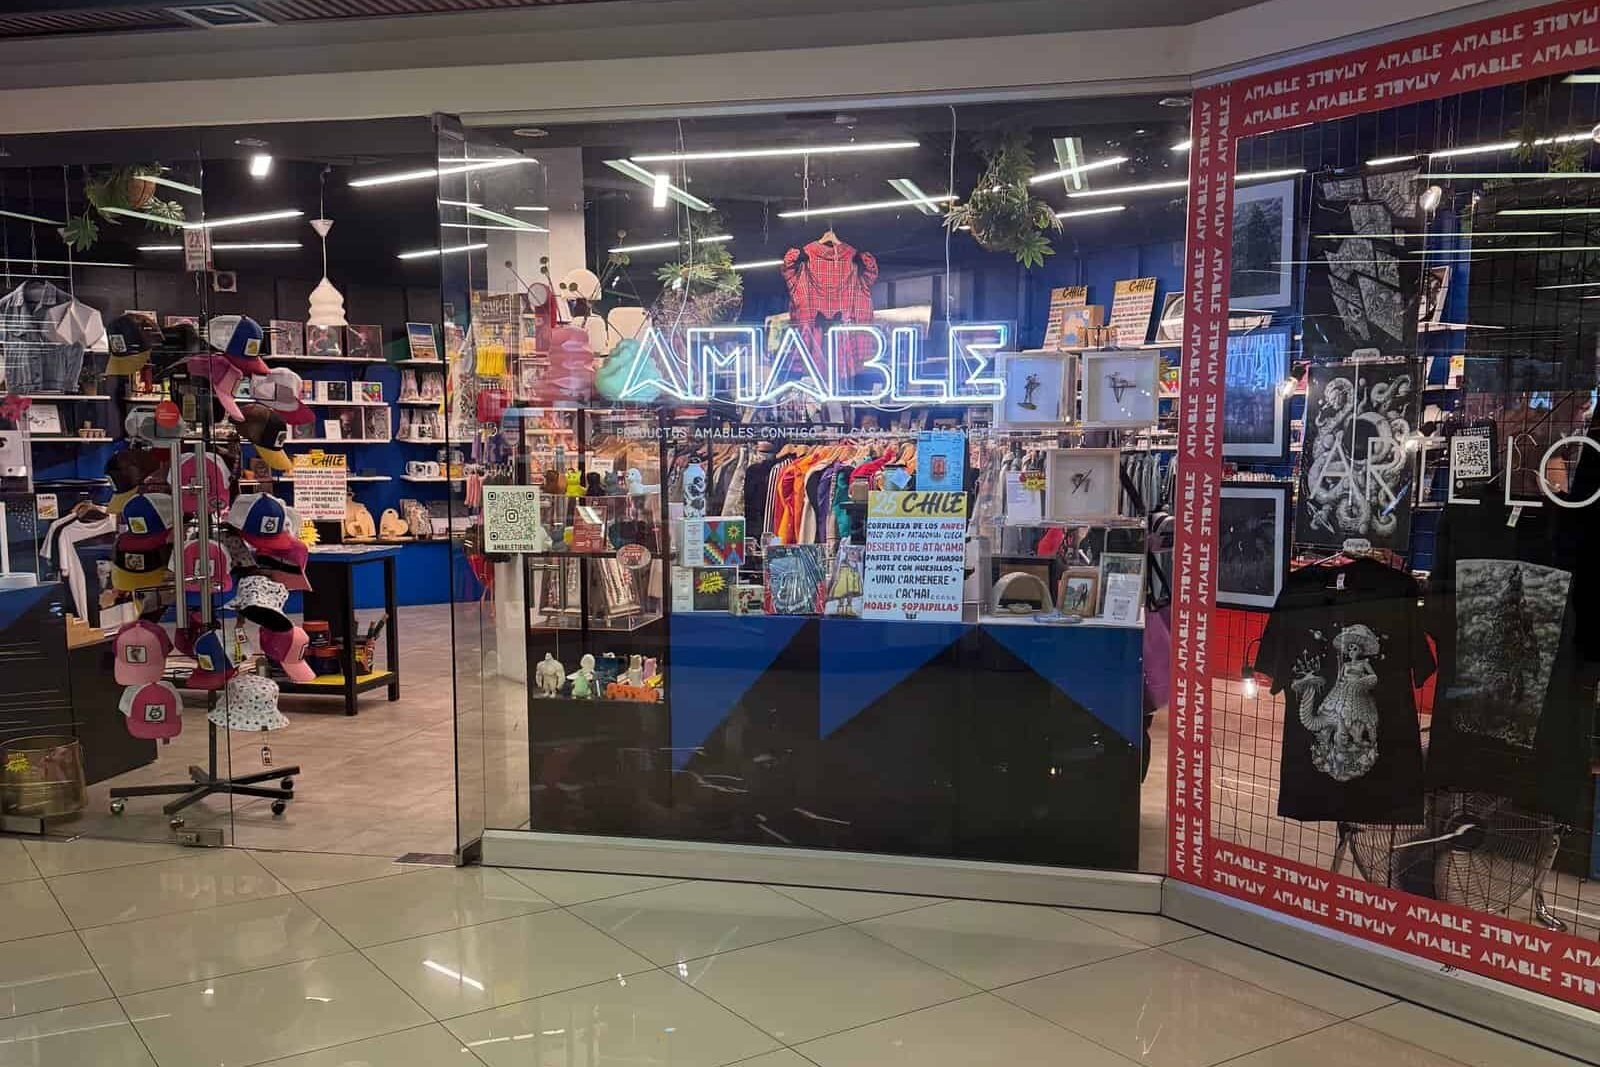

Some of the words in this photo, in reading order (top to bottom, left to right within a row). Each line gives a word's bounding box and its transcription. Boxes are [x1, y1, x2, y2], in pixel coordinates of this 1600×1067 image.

[1243, 101, 1300, 126] AMABLE
[1306, 86, 1368, 113] AMABLE
[1374, 71, 1441, 99] AMABLE
[1450, 52, 1523, 81] AMABLE
[1531, 37, 1600, 65] AMABL
[1244, 76, 1301, 102] AMABLE
[1306, 61, 1368, 88] AMABLE
[1376, 43, 1443, 71] AMABLE
[1451, 23, 1524, 54] AMABLE
[1532, 6, 1599, 36] MABLE
[1198, 100, 1212, 169] AMABLE
[1216, 94, 1231, 164] AMABLE
[1195, 172, 1209, 241] AMABLE
[1213, 170, 1230, 238] AMABLE
[1192, 247, 1206, 315] AMABLE
[1210, 246, 1225, 315] AMABLE
[619, 324, 1007, 402] AMABLE
[1187, 323, 1203, 388] AMABLE
[1206, 320, 1221, 386] AMABLE
[694, 427, 754, 439] AMABLES
[1185, 393, 1201, 458] AMABLE
[1203, 393, 1217, 458] AMABLE
[867, 522, 911, 530] CORDILLERA
[912, 522, 924, 530] DE
[925, 522, 938, 530] LOS
[902, 491, 966, 515] CHILE
[1183, 471, 1196, 535] AMABLE
[1199, 472, 1214, 537] AMABLE
[866, 542, 908, 552] DESIERTO
[909, 542, 921, 552] DE
[922, 542, 964, 552] ATACAMA
[866, 554, 892, 562] PASTEL
[892, 554, 902, 562] DE
[875, 564, 896, 572] MOTE
[897, 564, 913, 572] CON
[1180, 542, 1193, 604] AMABLE
[1197, 542, 1211, 605] AMABLE
[875, 575, 896, 585] VINO
[897, 575, 950, 586] CARMENERE
[895, 588, 931, 599] CACHAI
[1177, 609, 1190, 671] AMABLE
[1194, 611, 1208, 675] AMABLE
[1175, 678, 1188, 739] AMABLE
[1193, 681, 1205, 744] AMABLE
[1175, 747, 1187, 808] AMABLE
[1192, 749, 1204, 811] AMABLE
[1174, 812, 1186, 874] AMABLE
[1192, 817, 1204, 879] AMABLE
[1213, 869, 1266, 895] AMABLE
[1272, 889, 1329, 917] AMABLE
[1335, 907, 1397, 936] AMABLE
[1404, 929, 1472, 959] AMABLE
[1479, 950, 1553, 983] AMABLE
[1214, 849, 1267, 874] AMABLE
[1272, 865, 1330, 892] AMABLE
[1335, 884, 1398, 913] AMABLE
[1406, 905, 1473, 934] AMABLE
[1479, 923, 1552, 954] AMABLE
[1562, 947, 1600, 968] AMA
